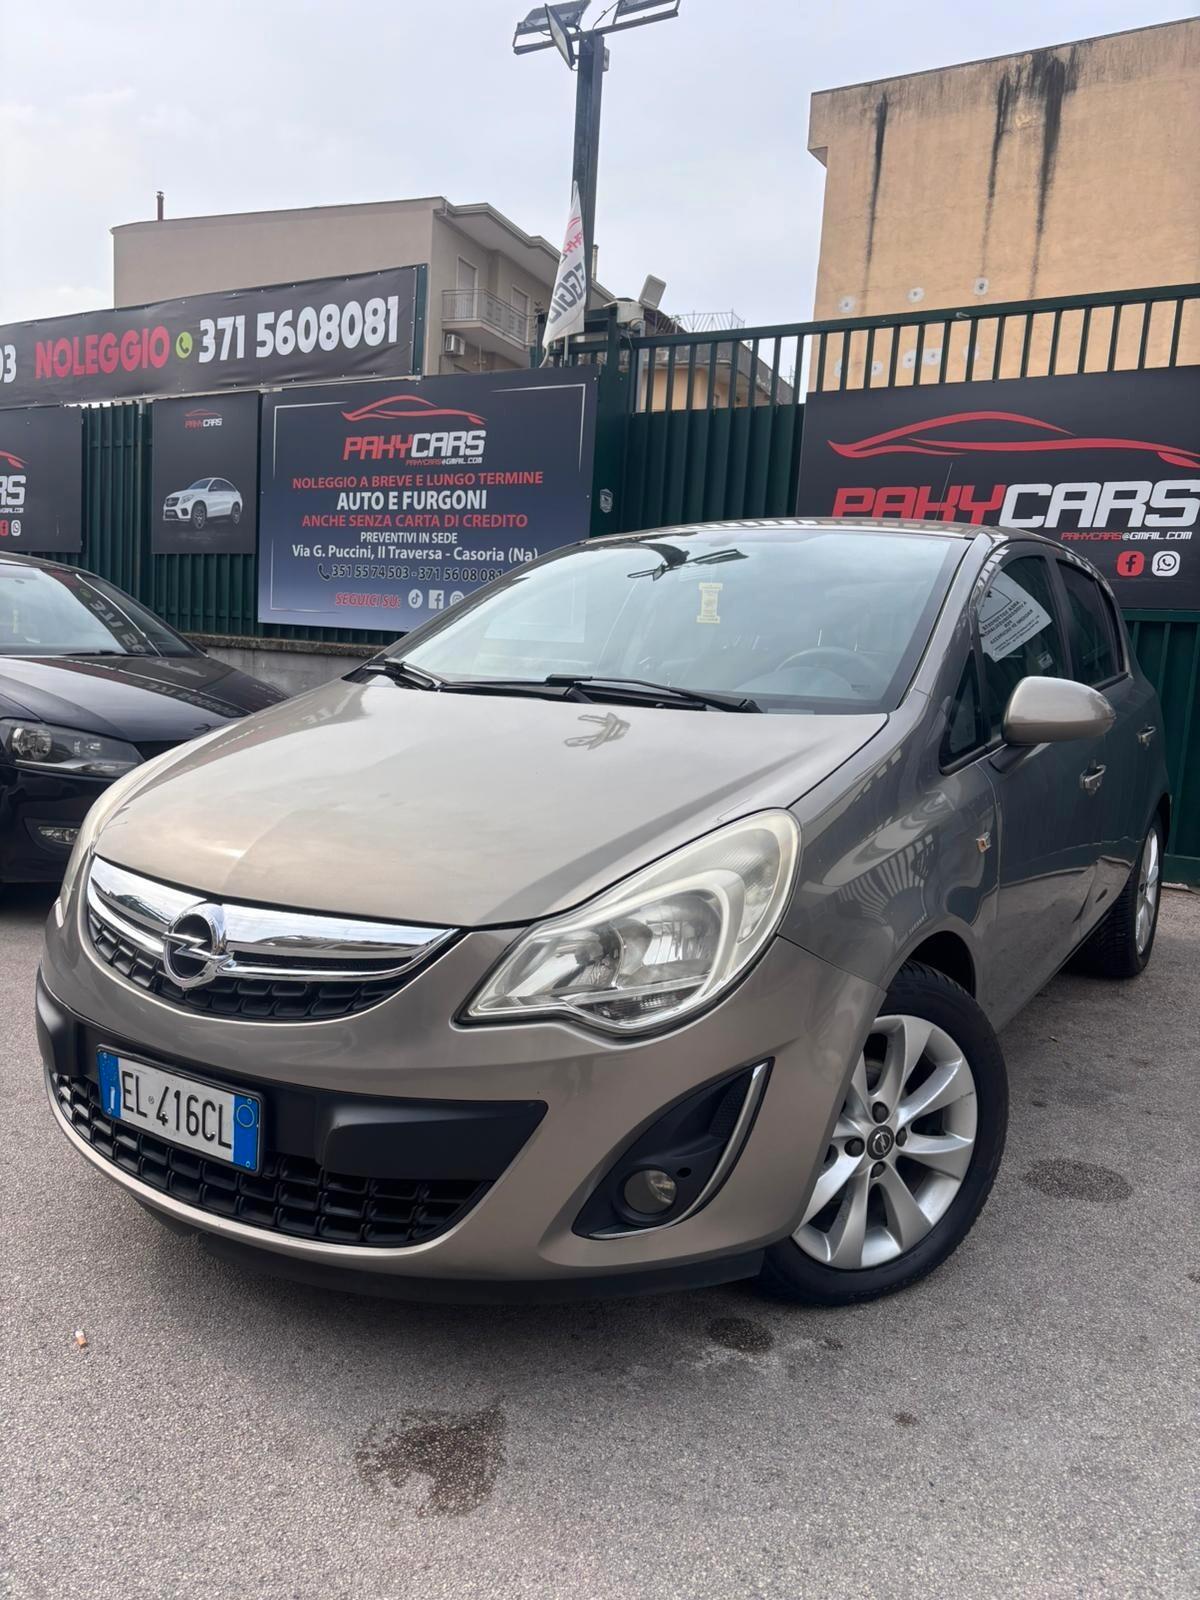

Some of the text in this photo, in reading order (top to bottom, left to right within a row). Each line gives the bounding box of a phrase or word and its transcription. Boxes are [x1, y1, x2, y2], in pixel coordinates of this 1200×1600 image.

[0, 295, 399, 384] 3 NOLEGGIO 371 5608081
[343, 430, 487, 460] PAKYCARS
[292, 471, 543, 489] NOLEGGIO A BREVE E LUNGO TERMINE
[336, 489, 487, 511] AUTO E FURGONI
[832, 479, 1200, 528] PAKYCARS
[302, 514, 528, 527] ANCHE SENZA CARTA DI CREDITO
[360, 531, 458, 544] PREVENTIVI IN SEDE
[1060, 531, 1193, 542] PAKYCARS@GMAIL.COM
[291, 544, 311, 557] Via
[312, 544, 326, 558] G.
[328, 544, 375, 560] Puccini,
[387, 545, 443, 560] Traversa
[453, 547, 505, 561] Casoria
[508, 547, 539, 563] (Na)
[331, 564, 352, 577] 351
[354, 564, 369, 578] 55
[370, 565, 386, 578] 74
[387, 565, 410, 579] 503
[418, 567, 441, 580] 371
[444, 567, 460, 581] 56
[461, 568, 478, 582] 08
[335, 593, 380, 607] SEGUICI
[121, 1070, 232, 1149] EL 416CL
